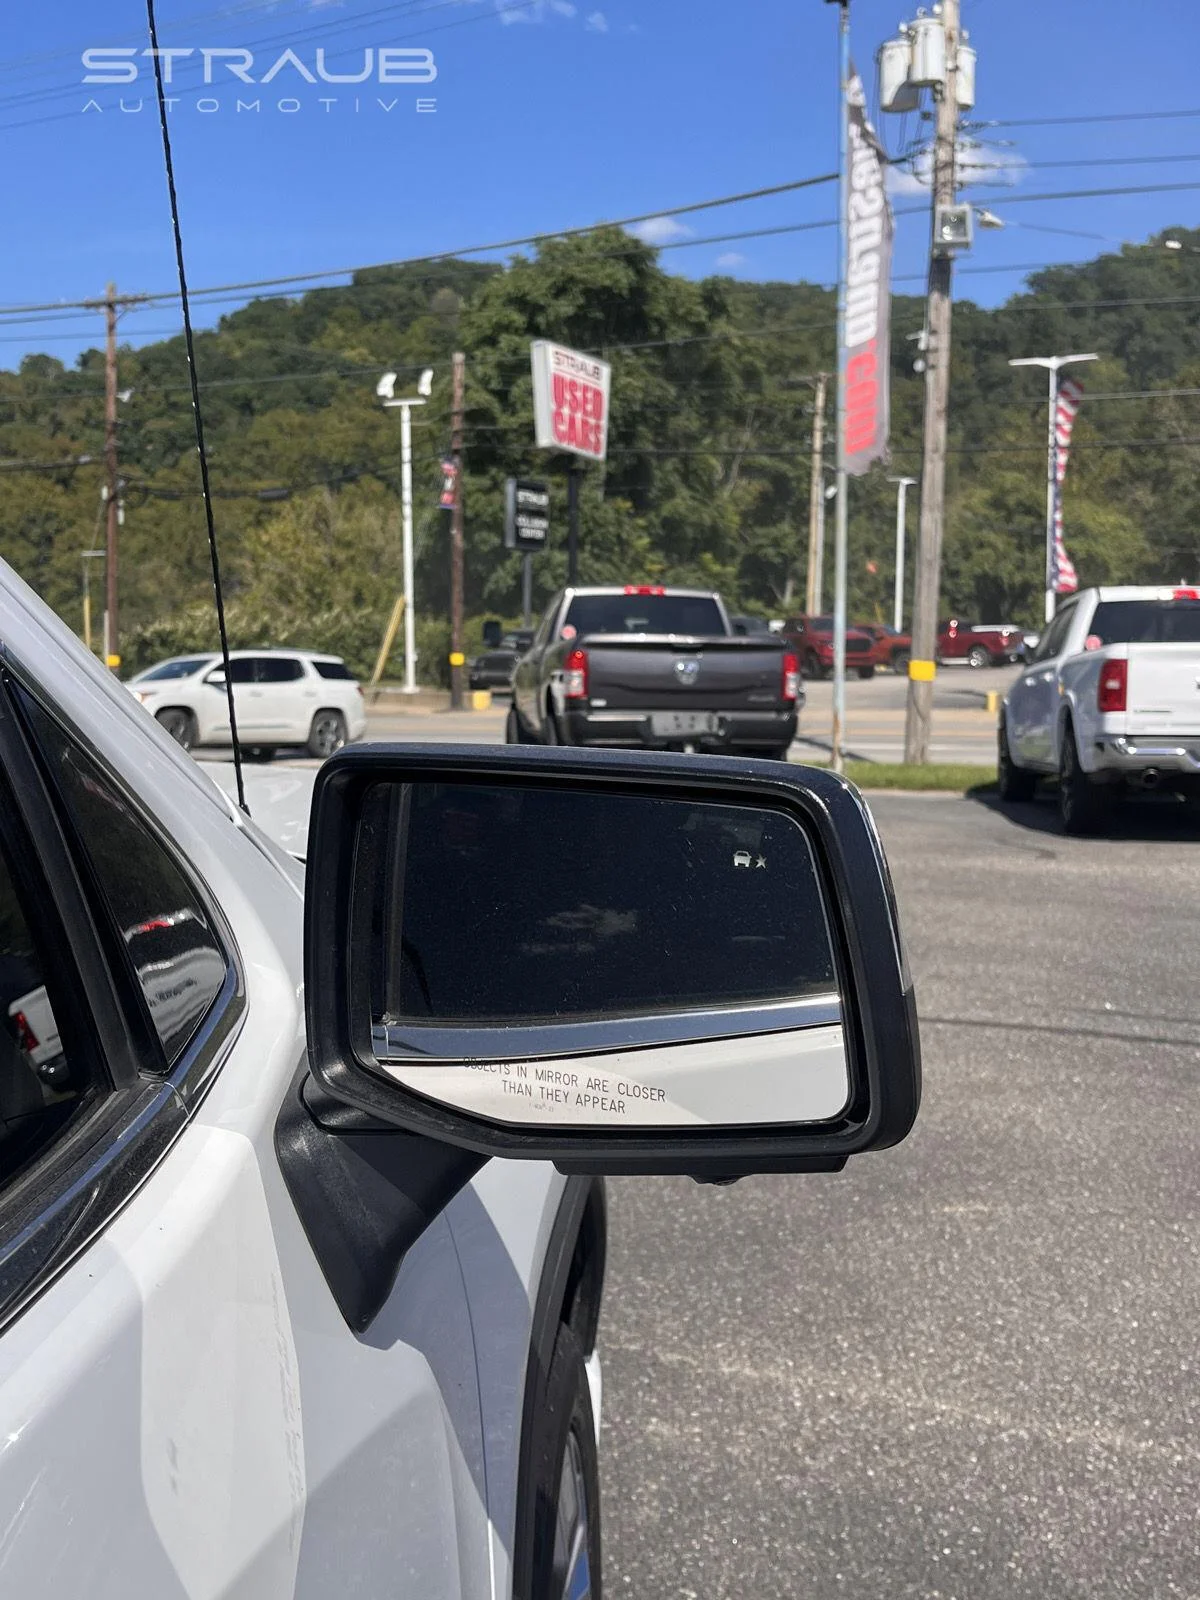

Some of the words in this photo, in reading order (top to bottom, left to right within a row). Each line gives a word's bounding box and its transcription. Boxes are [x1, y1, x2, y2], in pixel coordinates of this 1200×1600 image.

[553, 373, 604, 420] USED
[553, 408, 603, 455] CARS
[502, 1079, 533, 1098] THAN
[540, 1086, 570, 1104] THEY
[575, 1093, 626, 1114] APPEAR
[516, 1065, 528, 1079] IN
[535, 1068, 579, 1087] MIRROR
[586, 1077, 609, 1093] ARE
[617, 1082, 666, 1102] CLOSER
